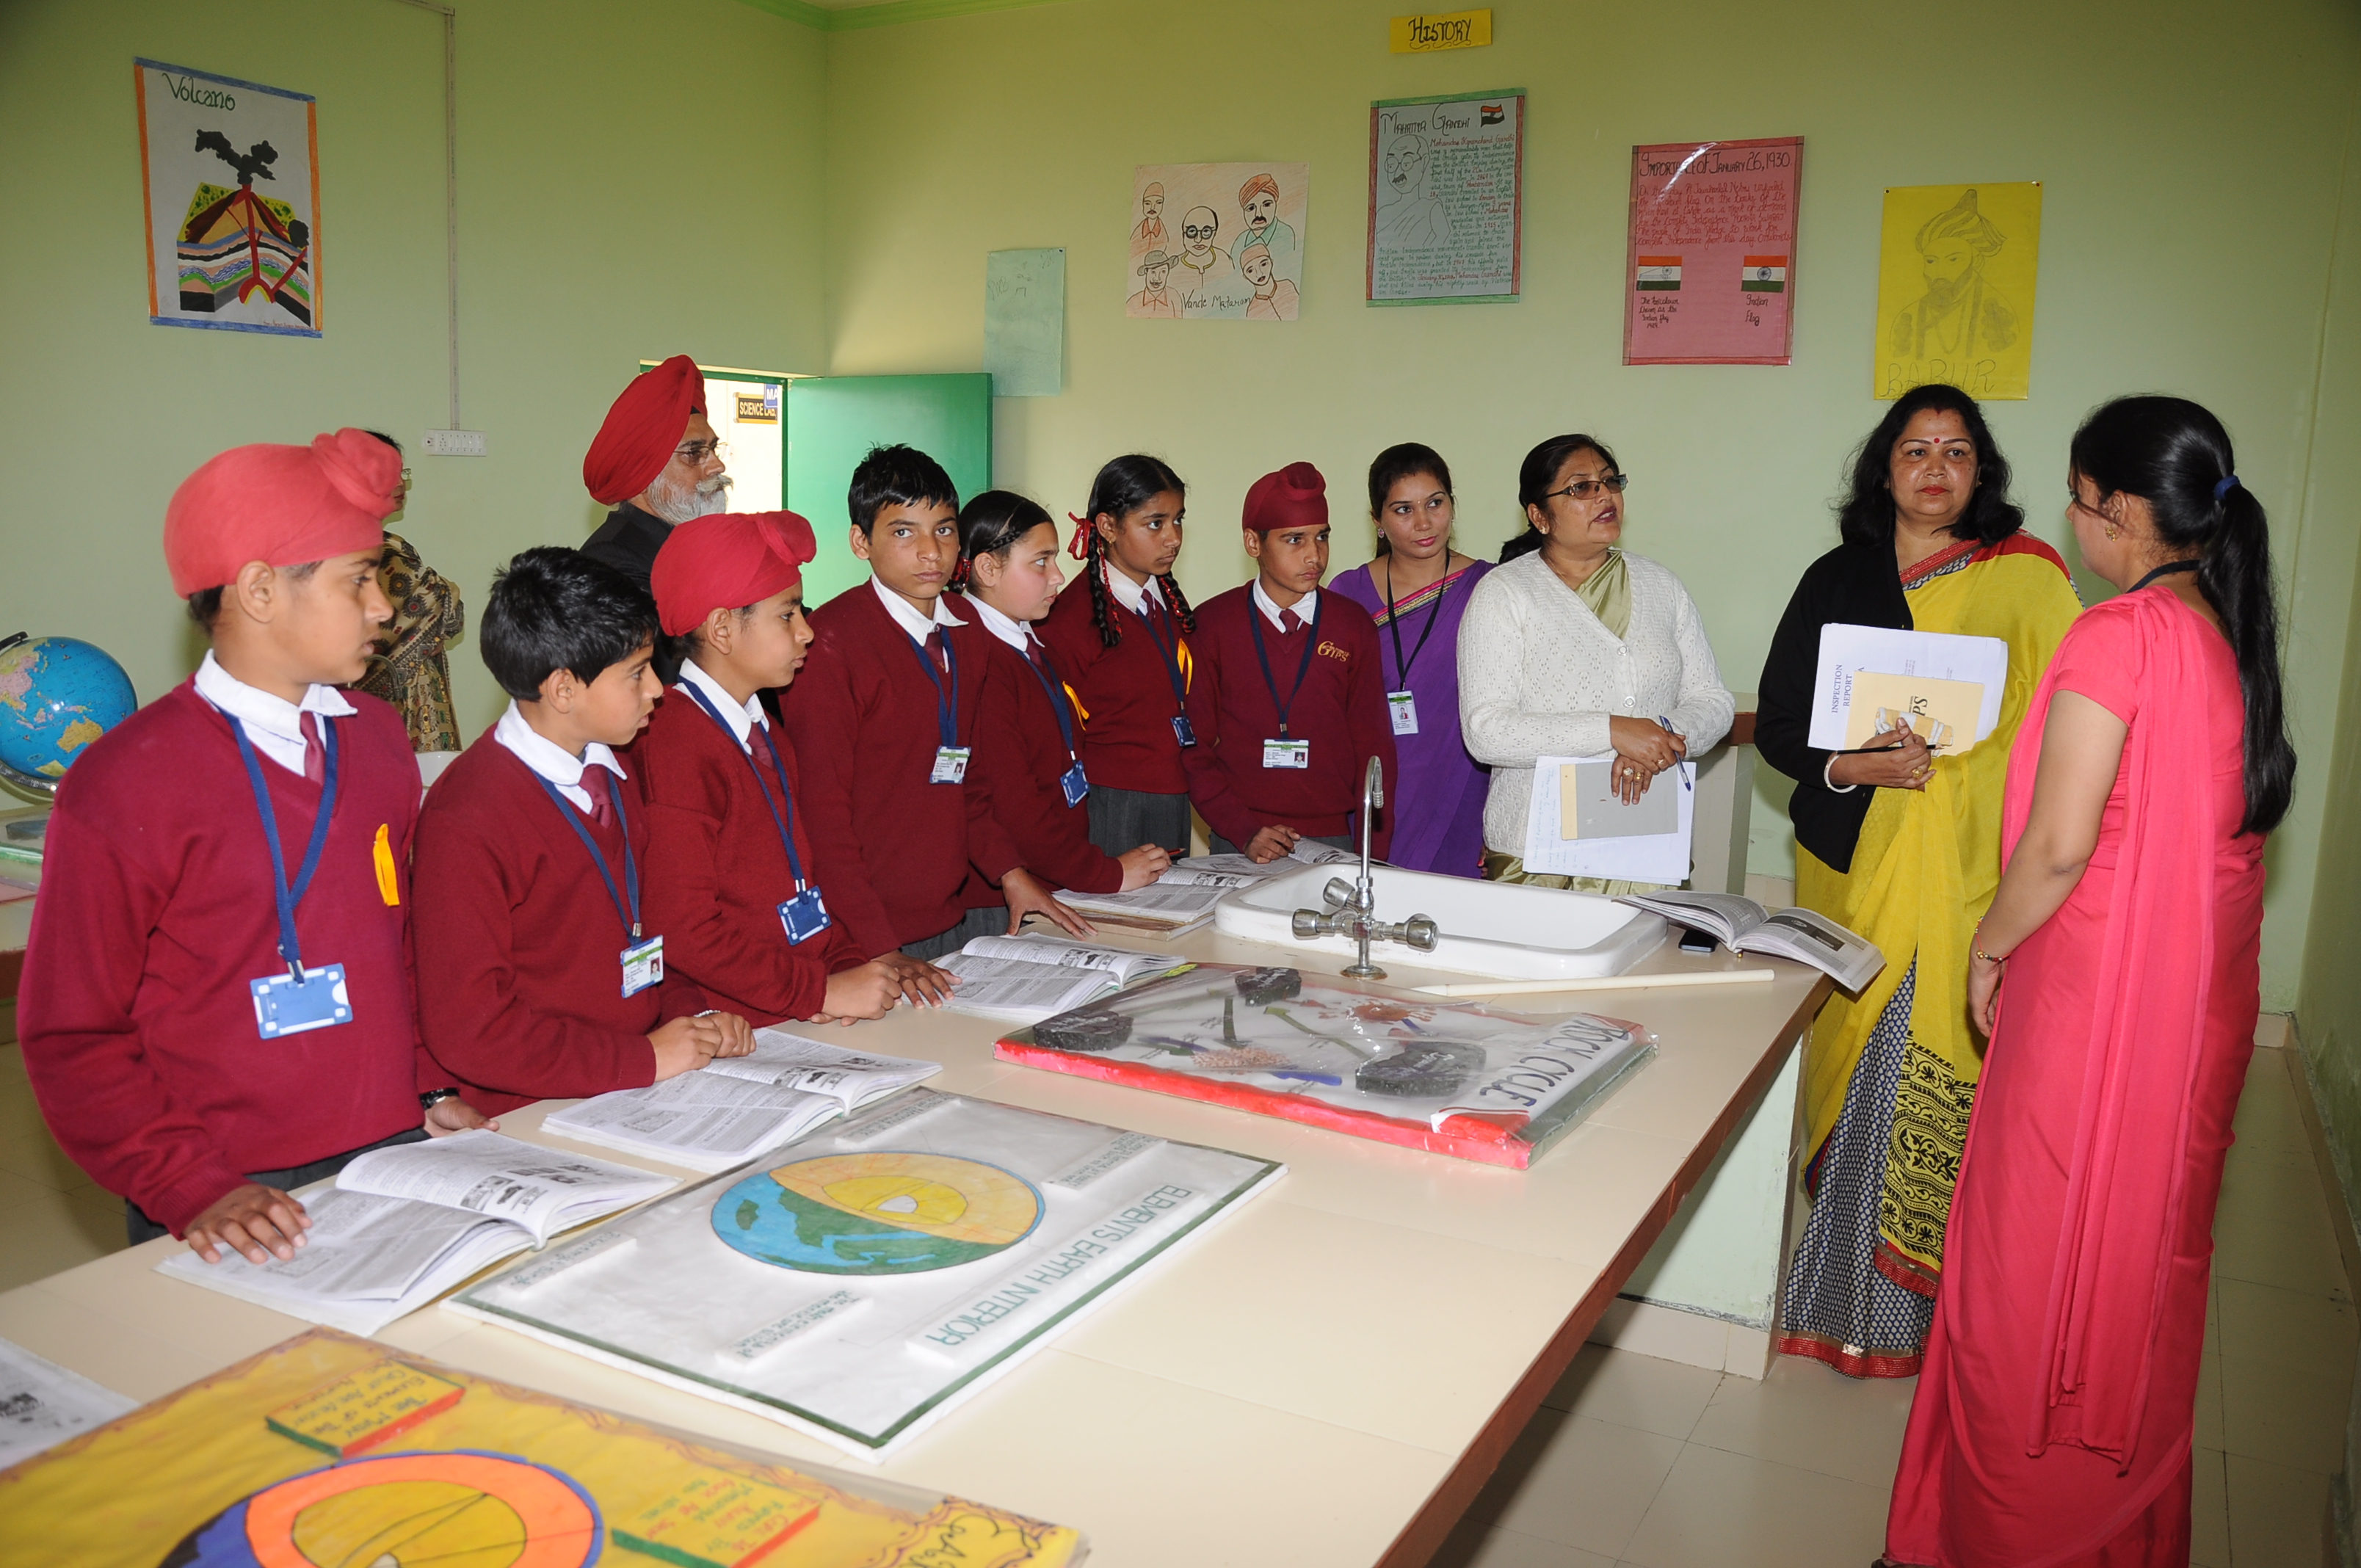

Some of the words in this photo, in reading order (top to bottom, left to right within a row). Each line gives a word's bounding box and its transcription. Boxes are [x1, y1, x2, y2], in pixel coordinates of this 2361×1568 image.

[1408, 18, 1471, 45] HISTORY
[162, 73, 236, 111] Volcano
[1380, 112, 1426, 134] MAHATMA
[1432, 104, 1470, 136] GANDHI
[1640, 152, 1695, 176] IMPORTACE
[1697, 153, 1711, 174] OF
[1708, 152, 1746, 173] JANUARY
[1747, 151, 1764, 171] 26,
[1182, 289, 1207, 309] Vande
[1746, 294, 1769, 307] Indian
[1745, 310, 1760, 327] Flag
[740, 402, 764, 415] SCIENCE
[1831, 664, 1843, 714] INSPECTION
[1843, 674, 1852, 707] REPORT
[1533, 1019, 1629, 1060] ROCK
[1479, 1056, 1575, 1108] CYCLE
[1092, 1184, 1190, 1243] ELEMENTS
[1028, 1238, 1108, 1287] EARTH
[924, 1281, 1039, 1346] INTERIOR
